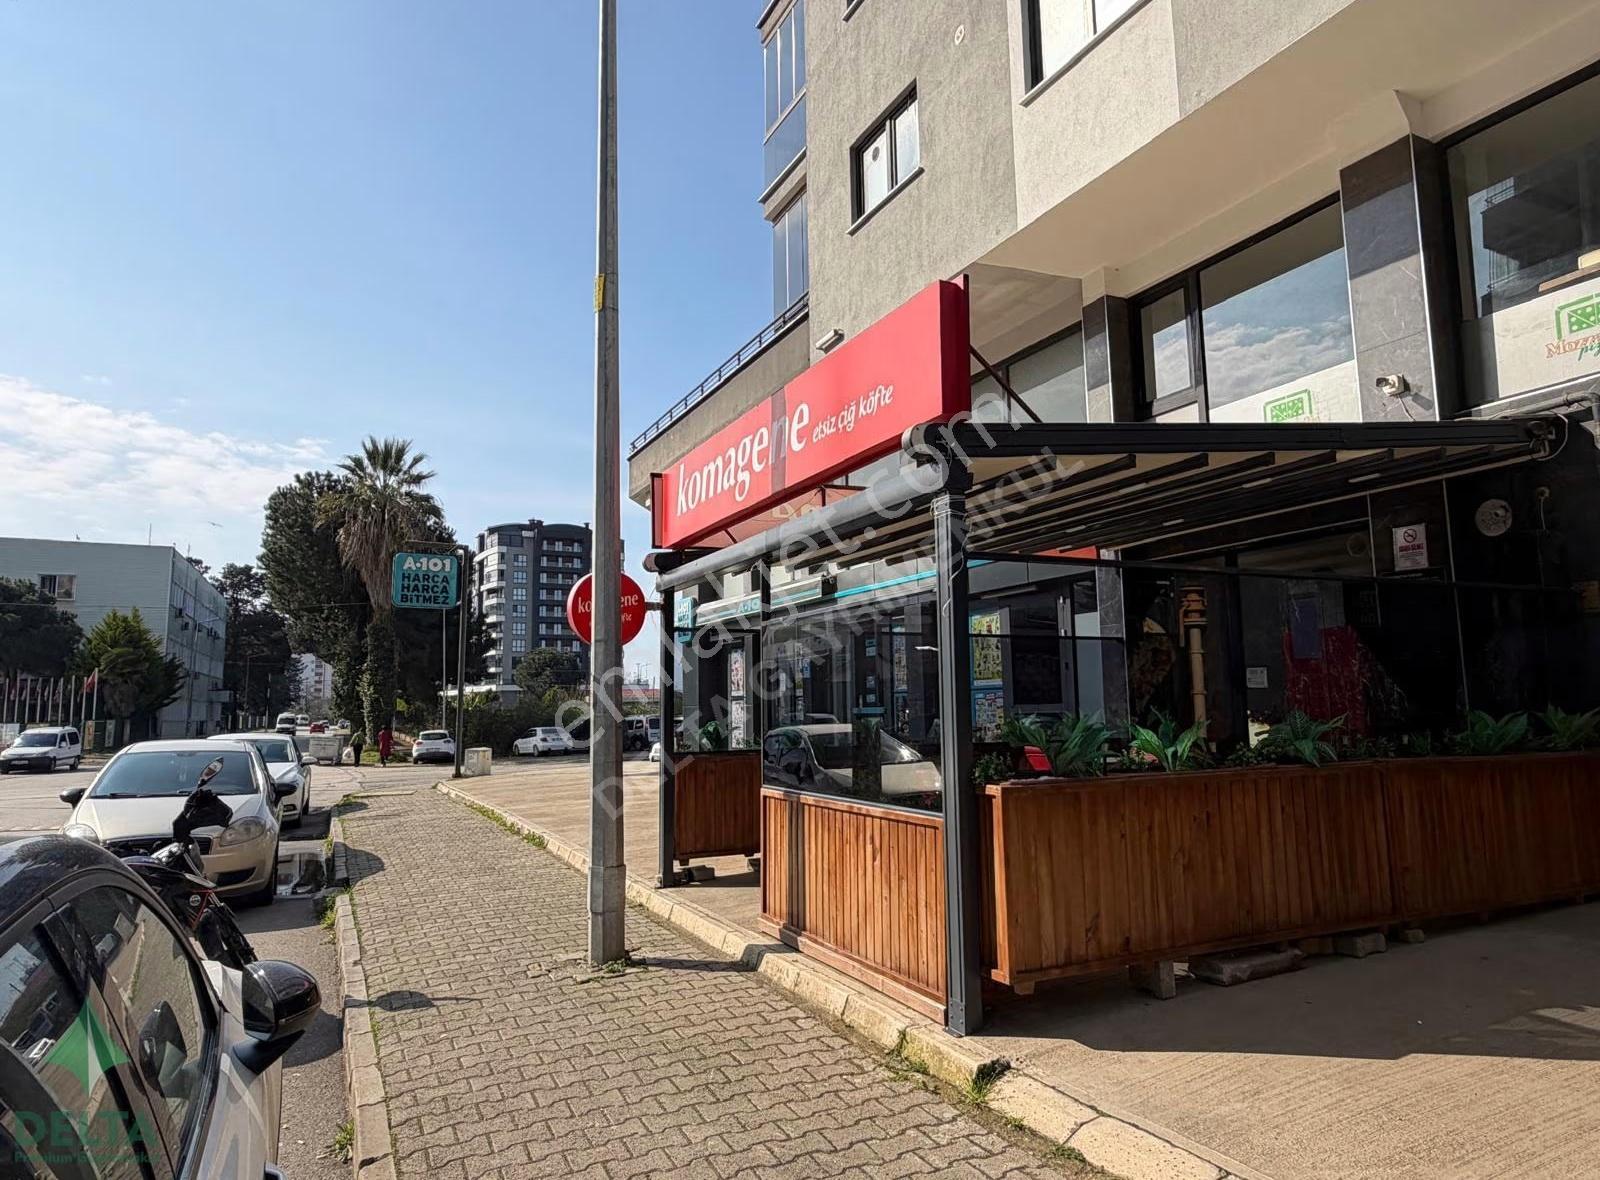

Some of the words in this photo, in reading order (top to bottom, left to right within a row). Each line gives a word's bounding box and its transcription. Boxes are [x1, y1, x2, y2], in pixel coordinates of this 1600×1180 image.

[677, 402, 810, 516] komagene
[812, 415, 837, 442] etsiz
[837, 400, 856, 432] çiğ
[858, 384, 894, 418] köfte
[401, 573, 450, 585] HARCA
[400, 583, 450, 596] HARCA
